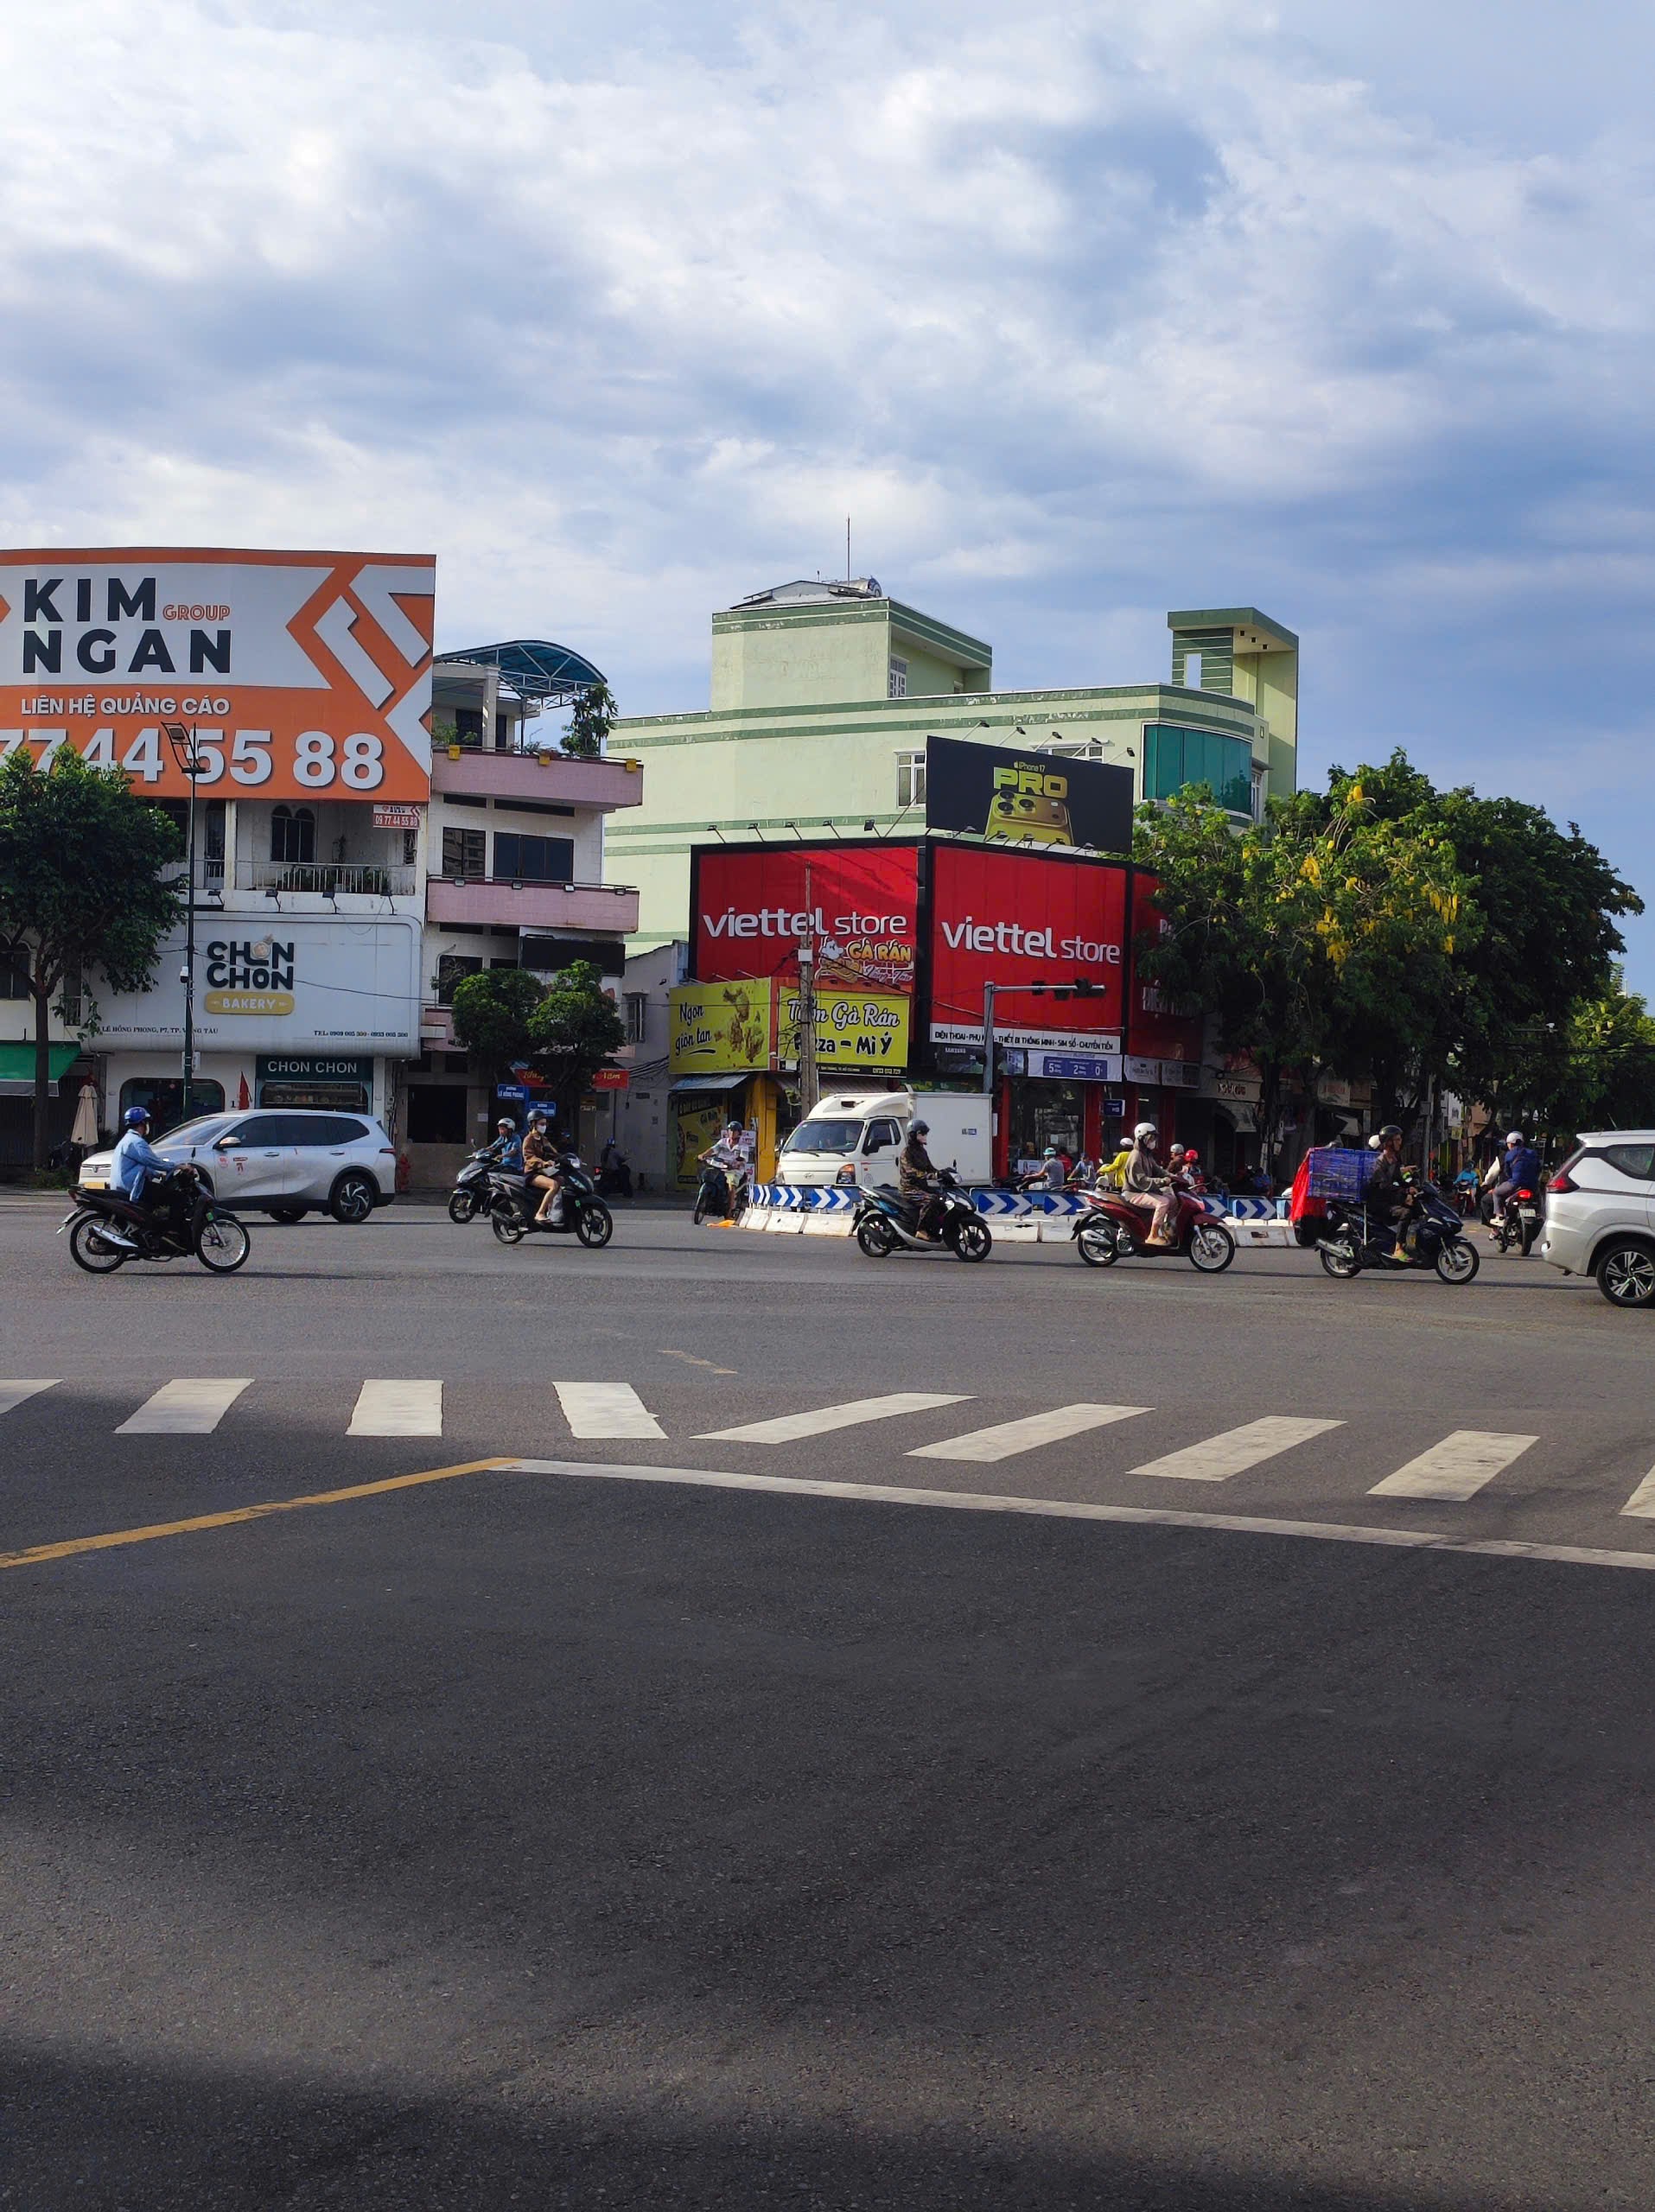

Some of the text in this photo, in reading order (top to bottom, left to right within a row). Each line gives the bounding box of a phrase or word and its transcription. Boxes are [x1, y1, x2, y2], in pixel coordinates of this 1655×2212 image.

[24, 577, 231, 622] KIM GROUP
[22, 629, 232, 673] NGAN
[21, 692, 230, 718] LIÊN HỆ QUẢNG CÁO
[182, 728, 273, 785] 55
[293, 730, 384, 790] 88
[993, 766, 1068, 799] PRO
[703, 907, 907, 938] viettel store
[848, 938, 912, 962] GÀ RÁN
[941, 916, 1120, 964] viettel store
[207, 962, 294, 990] CHON
[222, 997, 277, 1010] BAKERY
[680, 1002, 704, 1027] Ngon
[831, 1001, 861, 1030] Gà
[863, 1003, 901, 1027] Rán
[697, 1027, 710, 1045] tan
[794, 1032, 837, 1052] Pza
[856, 1036, 876, 1055] Mì
[880, 1032, 893, 1055] Ý
[267, 1060, 357, 1073] CHON CHON
[1048, 1063, 1054, 1072] 5
[1073, 1065, 1079, 1075] 2
